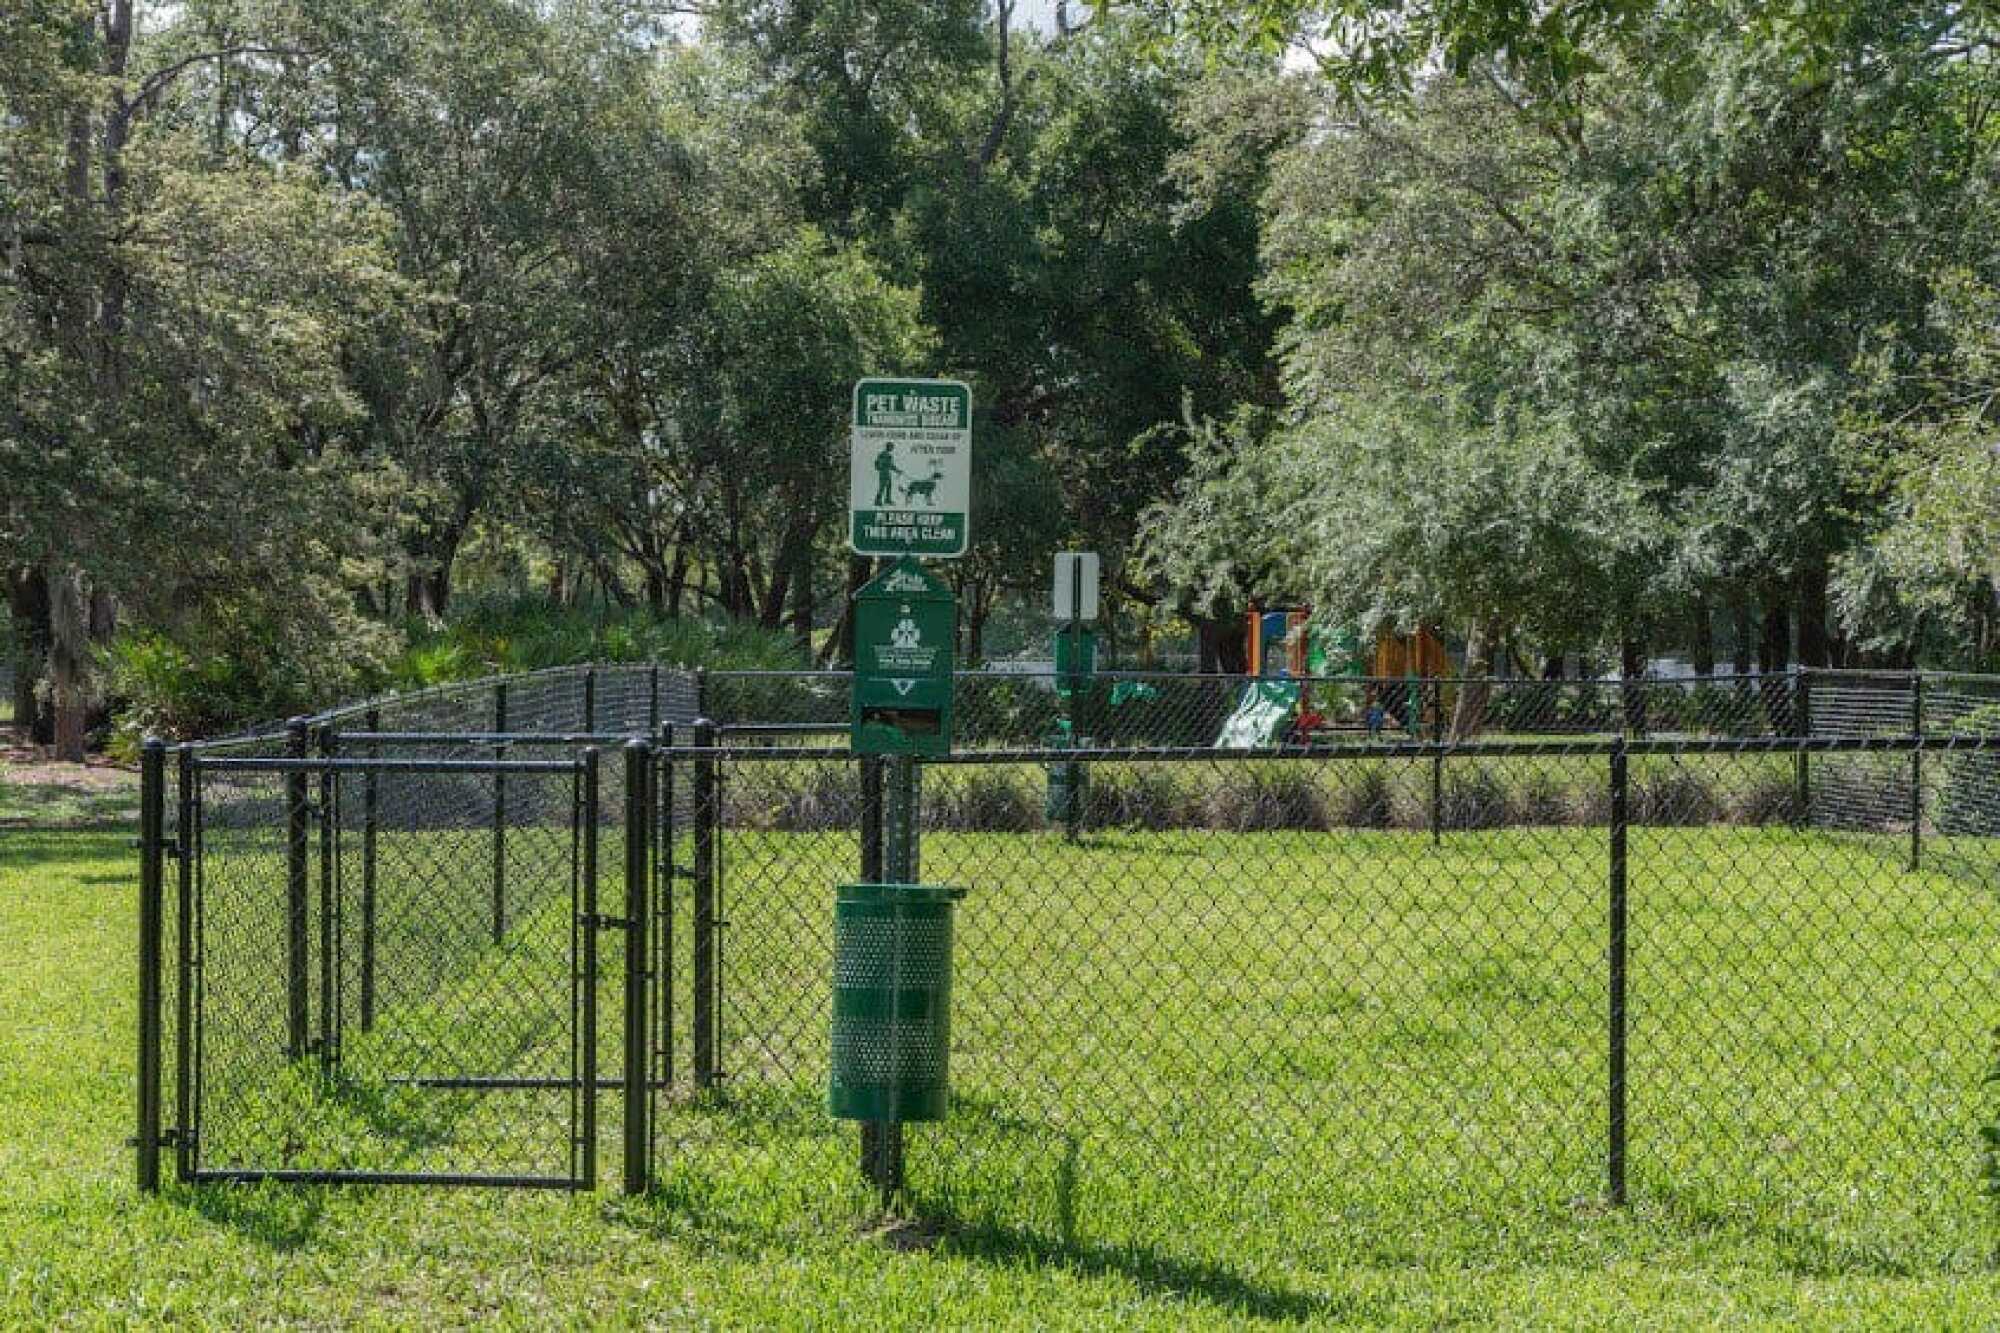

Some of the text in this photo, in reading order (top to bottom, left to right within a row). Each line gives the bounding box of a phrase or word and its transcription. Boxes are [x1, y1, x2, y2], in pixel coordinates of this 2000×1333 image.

[866, 394, 960, 413] PET WASTE
[922, 528, 956, 540] CLEAN
